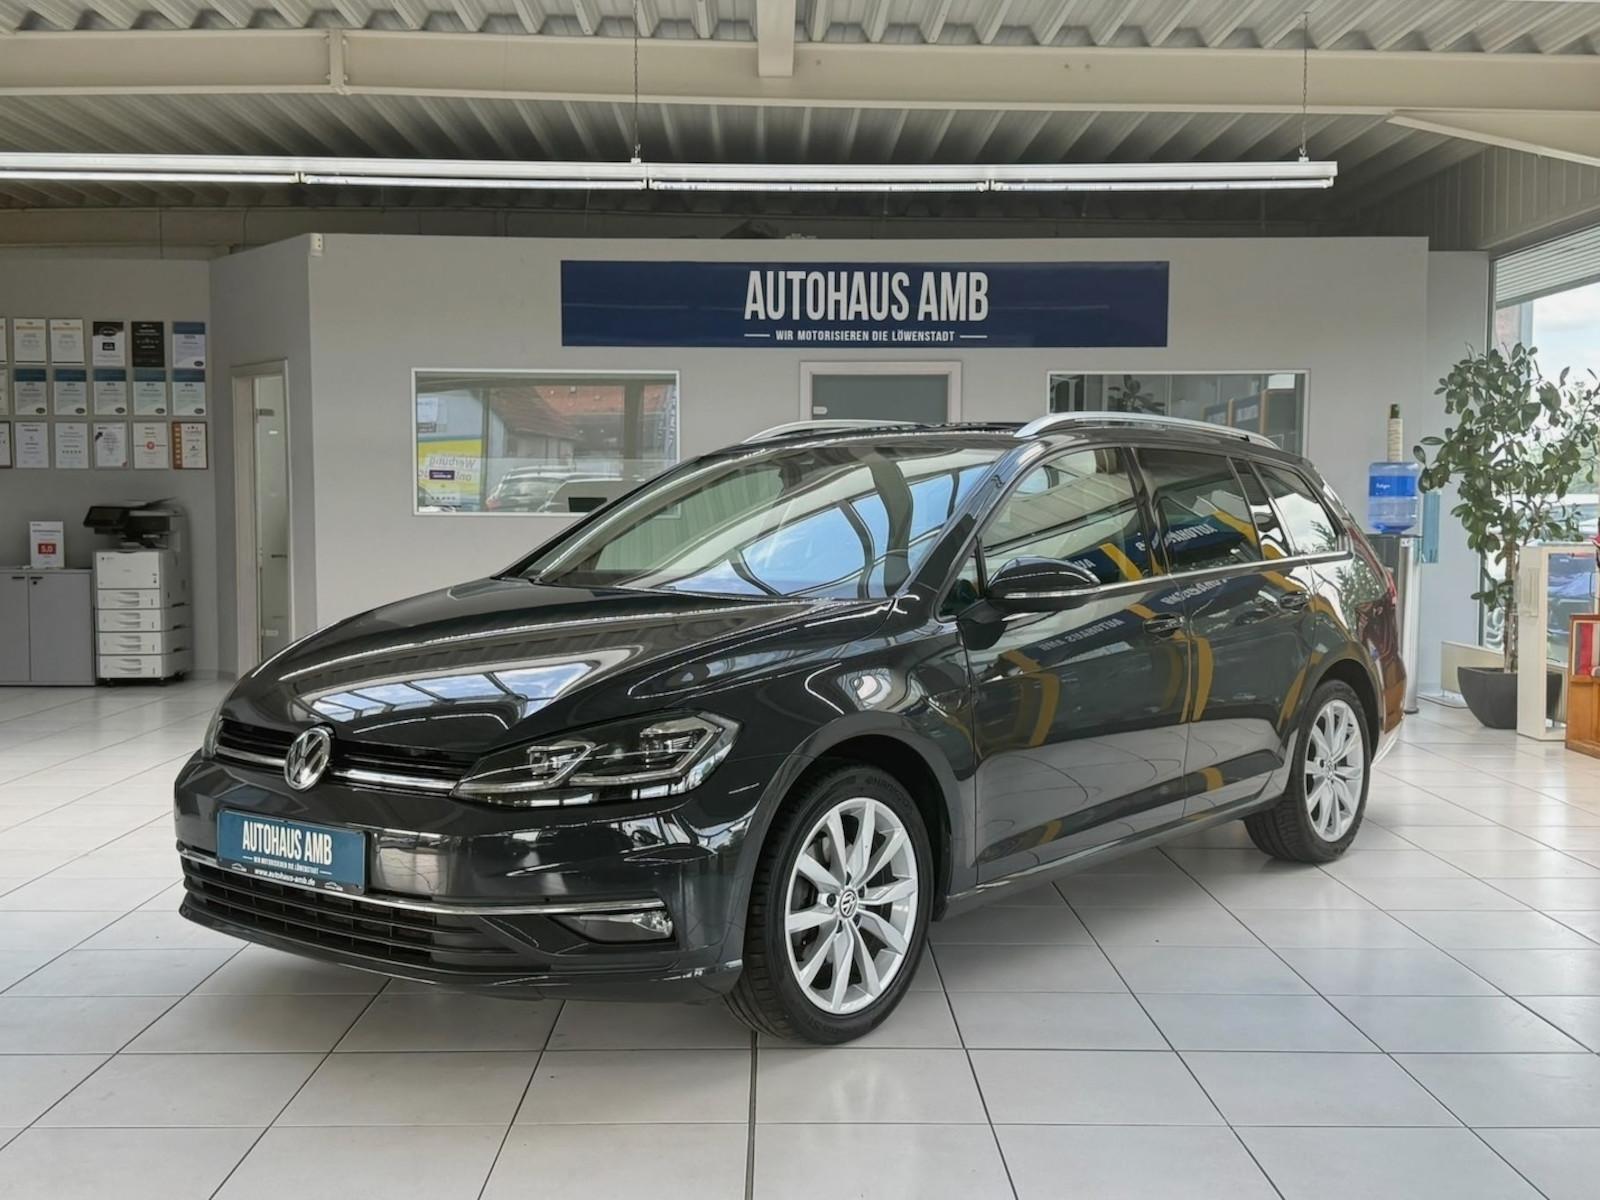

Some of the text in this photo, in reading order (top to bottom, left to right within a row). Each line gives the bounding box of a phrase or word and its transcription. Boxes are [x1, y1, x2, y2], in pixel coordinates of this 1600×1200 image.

[744, 270, 989, 322] AUTOHAUS AMB
[775, 328, 955, 341] WIR MOTORISIEREN DIE LÖWENSTADT
[242, 821, 332, 865] AUTOHAUS AMB
[254, 868, 316, 886] www.autohaus-amb.de
